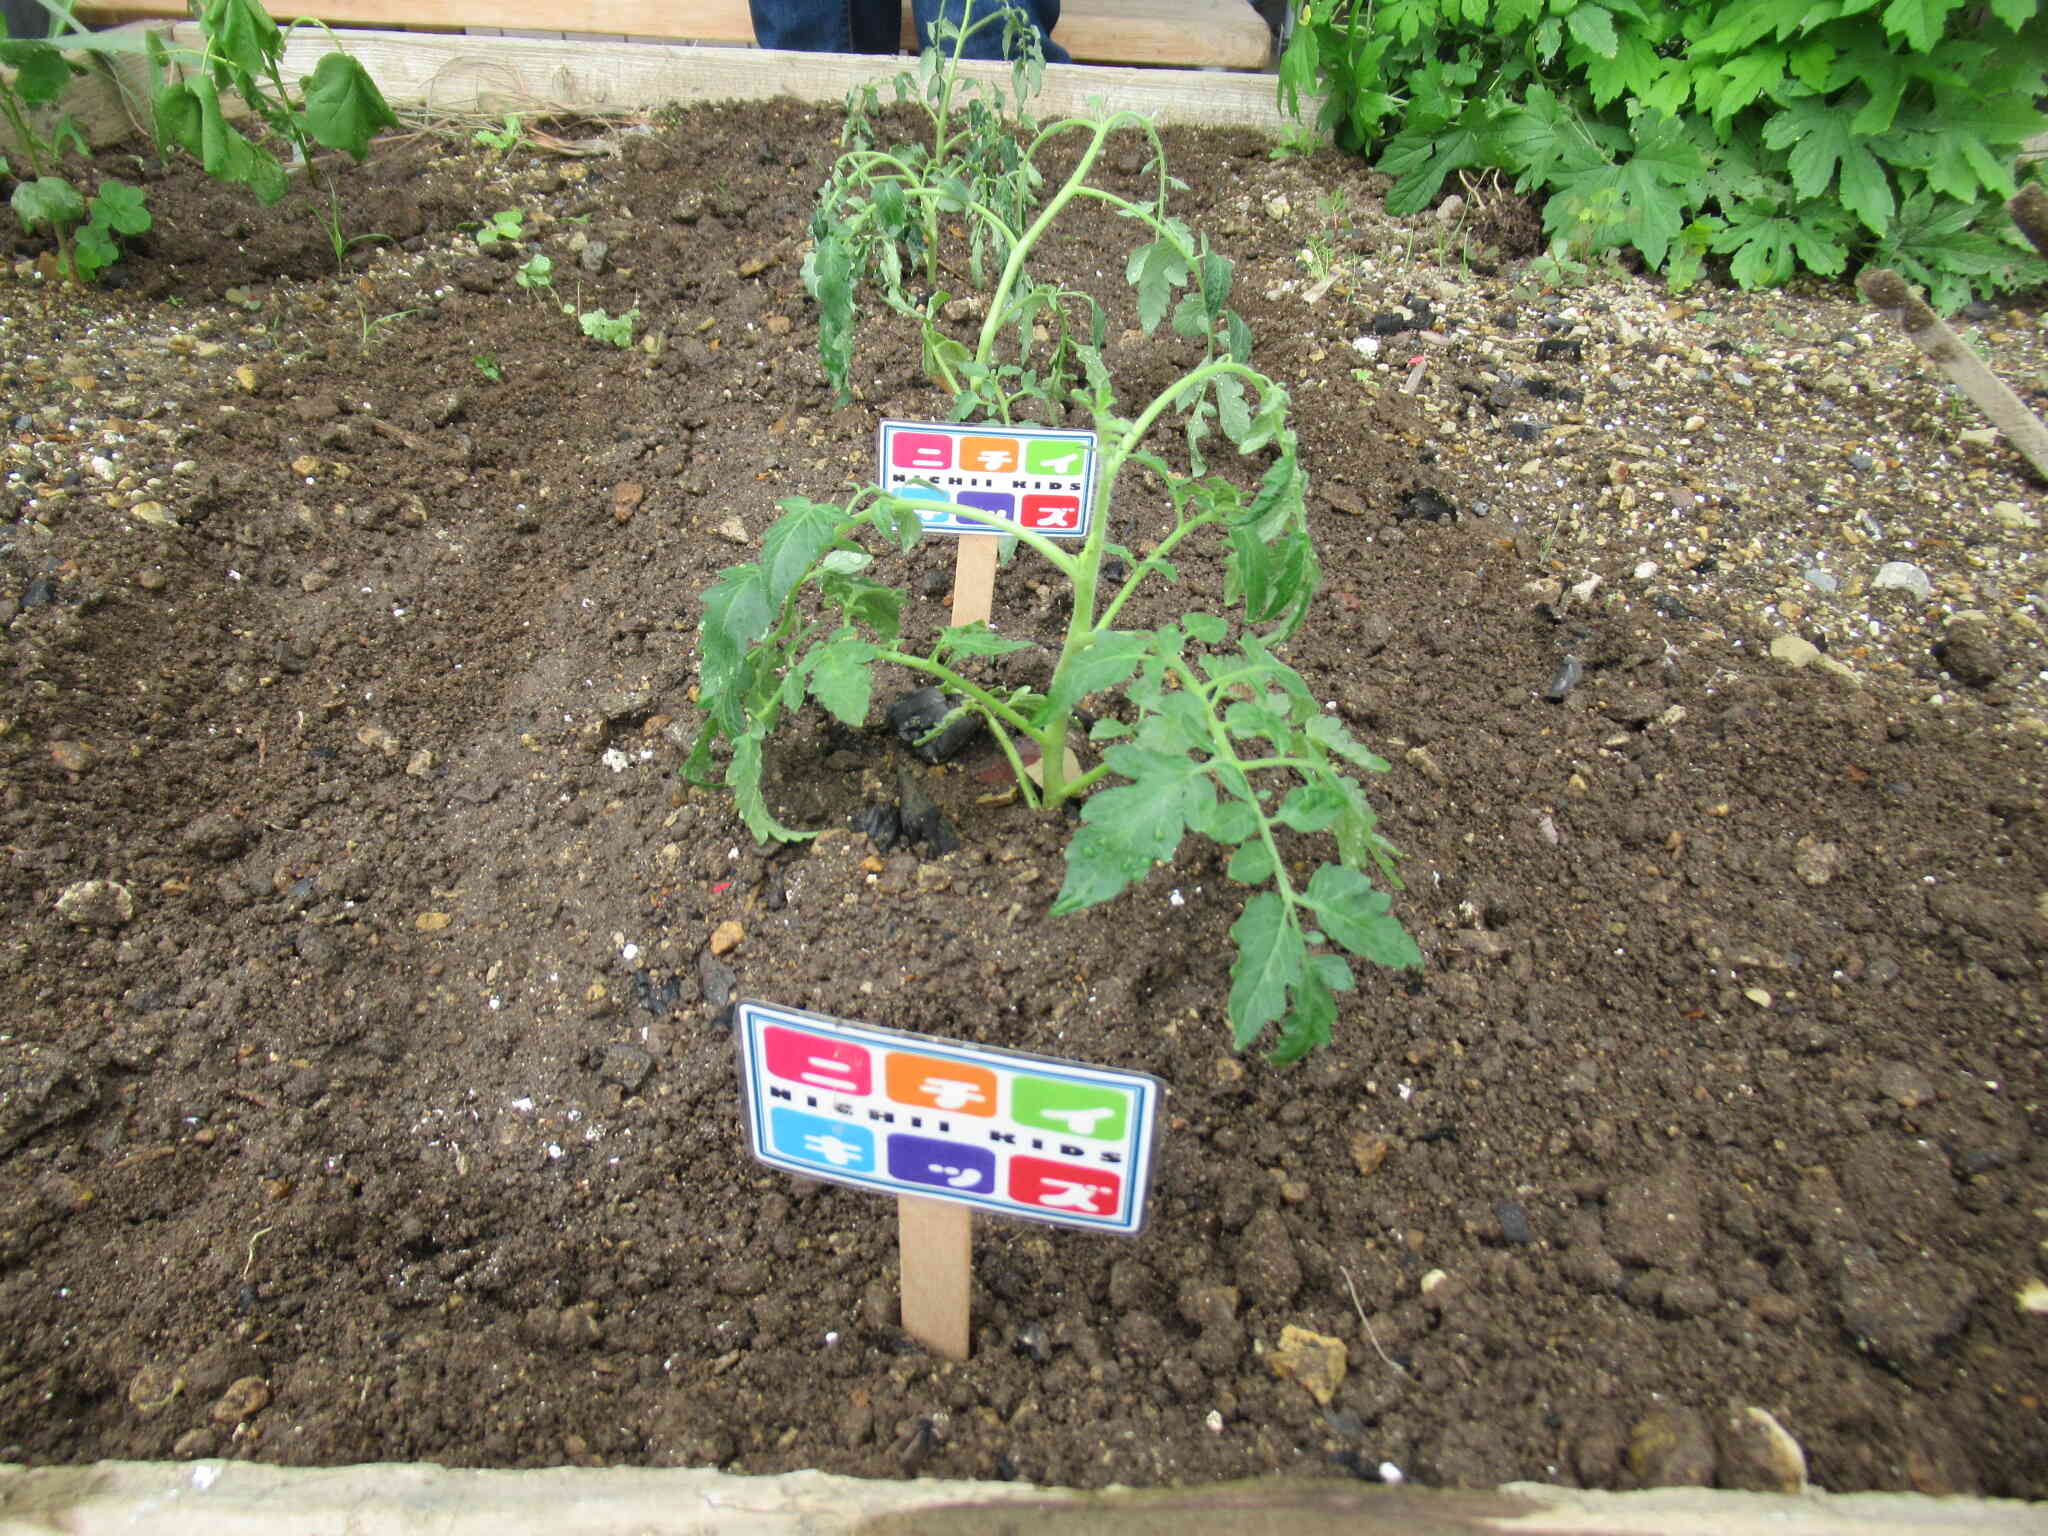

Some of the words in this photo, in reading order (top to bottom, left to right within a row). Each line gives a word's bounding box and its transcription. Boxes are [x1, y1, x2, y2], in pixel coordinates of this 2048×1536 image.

[892, 474, 993, 488] NCHII
[1012, 479, 1081, 491] KIDS
[912, 447, 1078, 473] ニチイ
[770, 1085, 951, 1133] NICHII
[989, 1129, 1122, 1164] KIDS
[801, 1055, 1115, 1136] ニチイ
[803, 1133, 1112, 1212] キッズ
